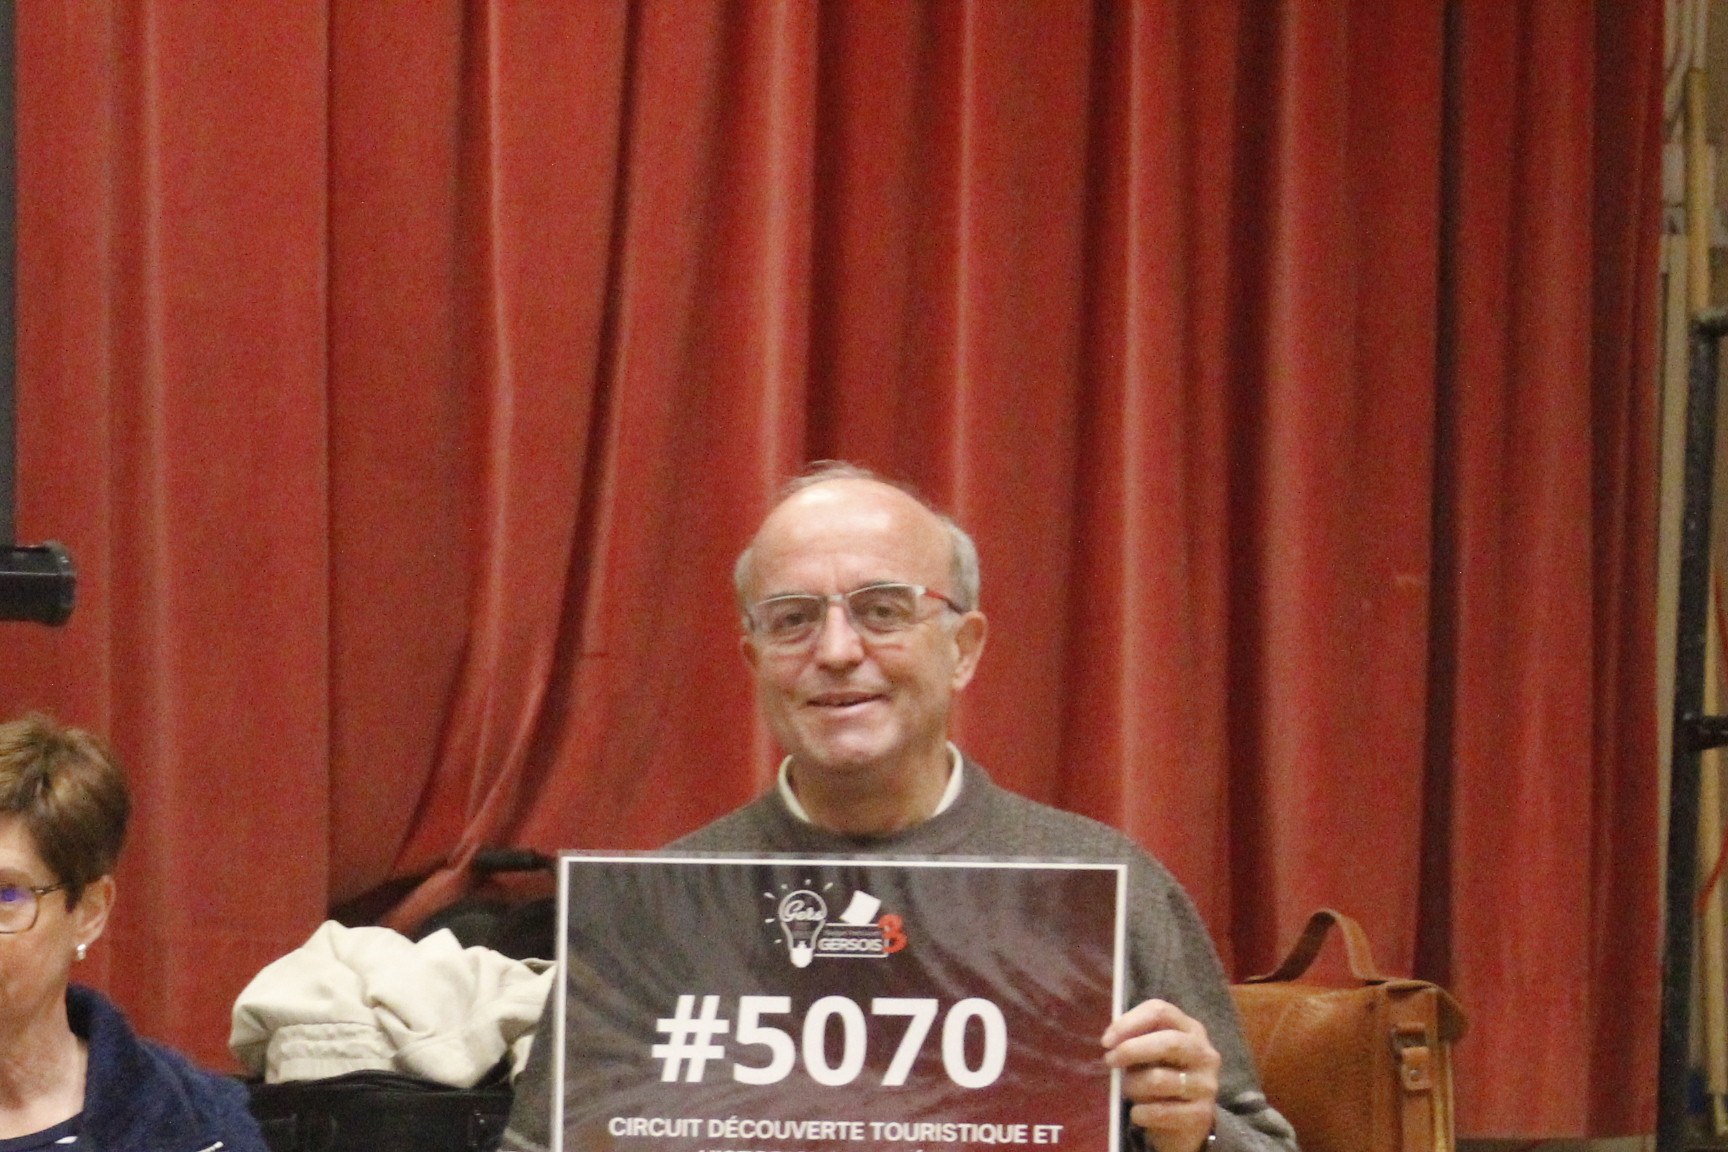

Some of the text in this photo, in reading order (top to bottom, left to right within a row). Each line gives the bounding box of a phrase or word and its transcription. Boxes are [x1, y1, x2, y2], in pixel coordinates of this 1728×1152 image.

[818, 938, 883, 951] GERSOIS
[878, 914, 907, 953] 3
[651, 994, 1008, 1088] #5070
[608, 1115, 1063, 1144] CIRCUIT DÉCOUVERTE TOURISTIQUE ET
